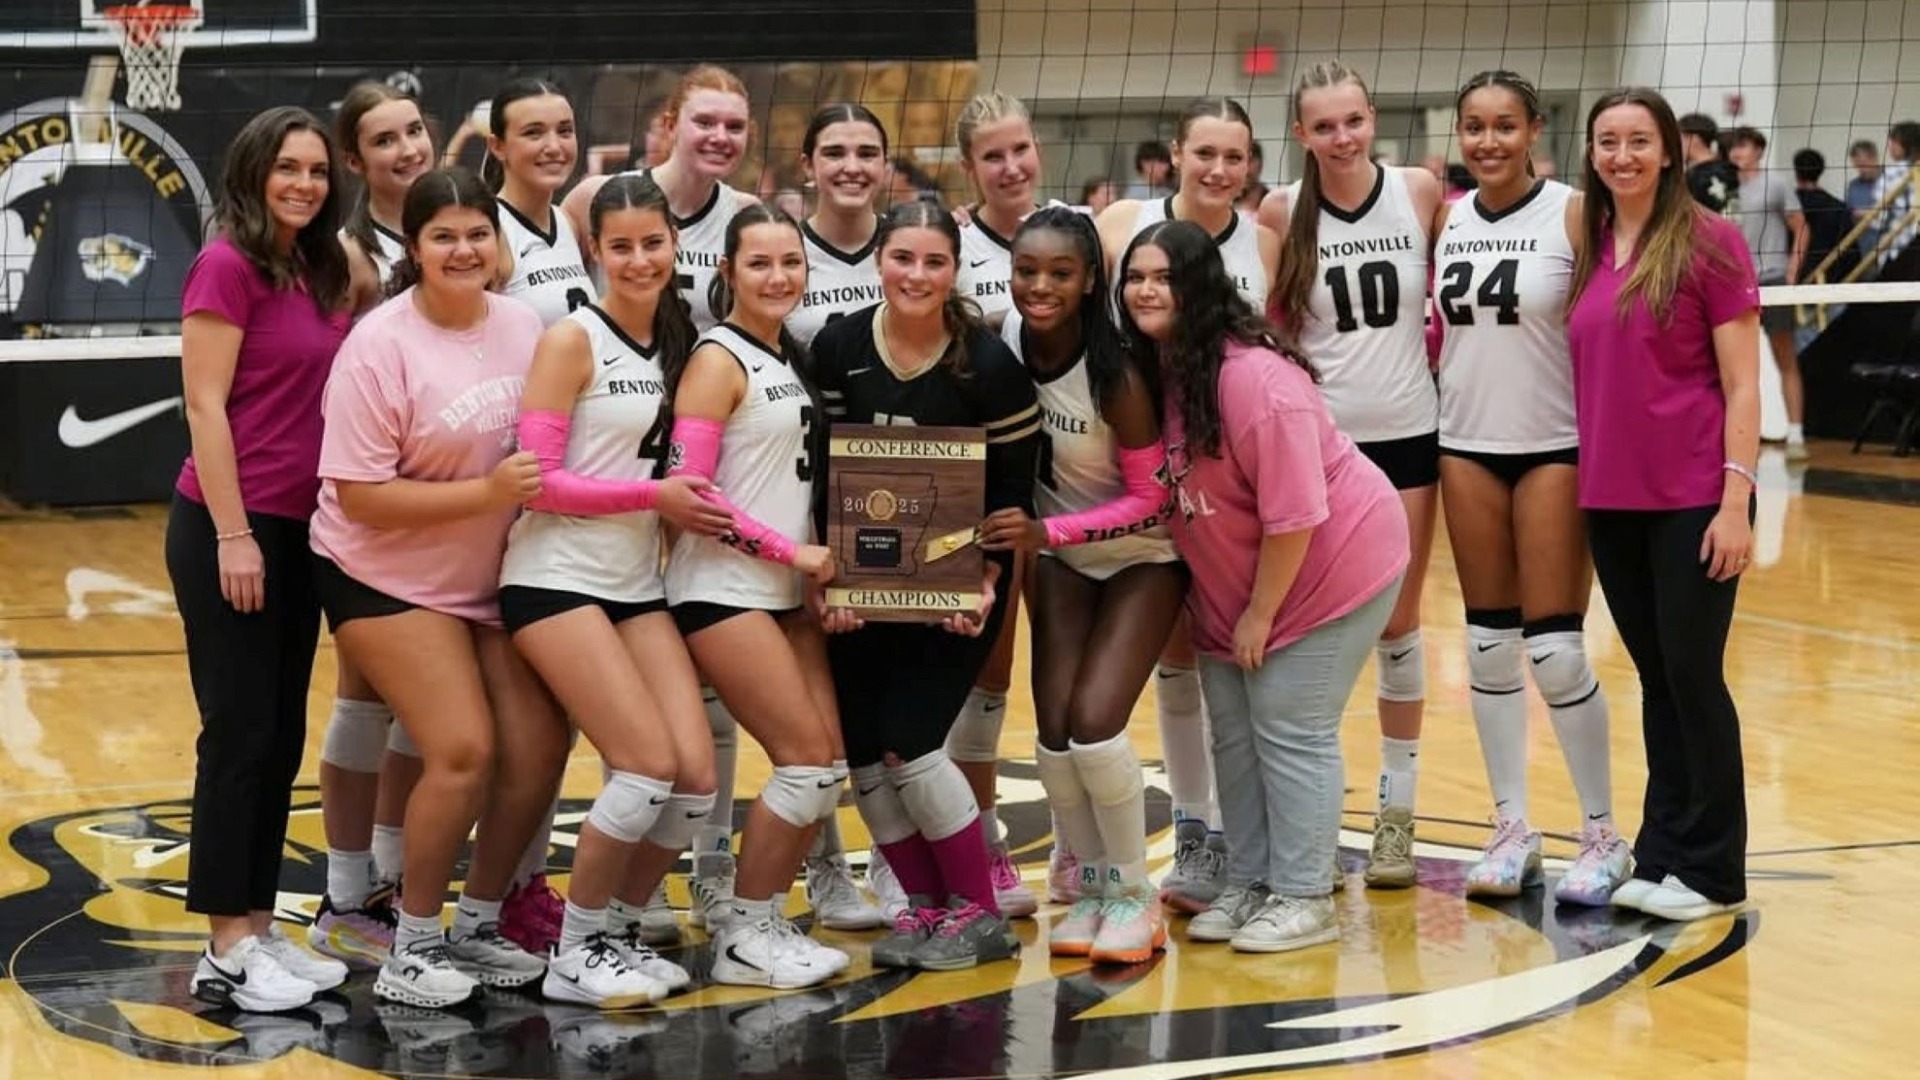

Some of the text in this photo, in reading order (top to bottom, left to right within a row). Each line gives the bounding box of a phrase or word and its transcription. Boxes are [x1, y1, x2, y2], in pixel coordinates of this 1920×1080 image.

[1444, 239, 1537, 256] BENTONVILLE
[1325, 260, 1399, 333] 10
[1440, 259, 1519, 326] 24
[637, 415, 671, 480] 4
[847, 440, 971, 457] CONFERENCE
[848, 590, 961, 607] CHAMPIONS
